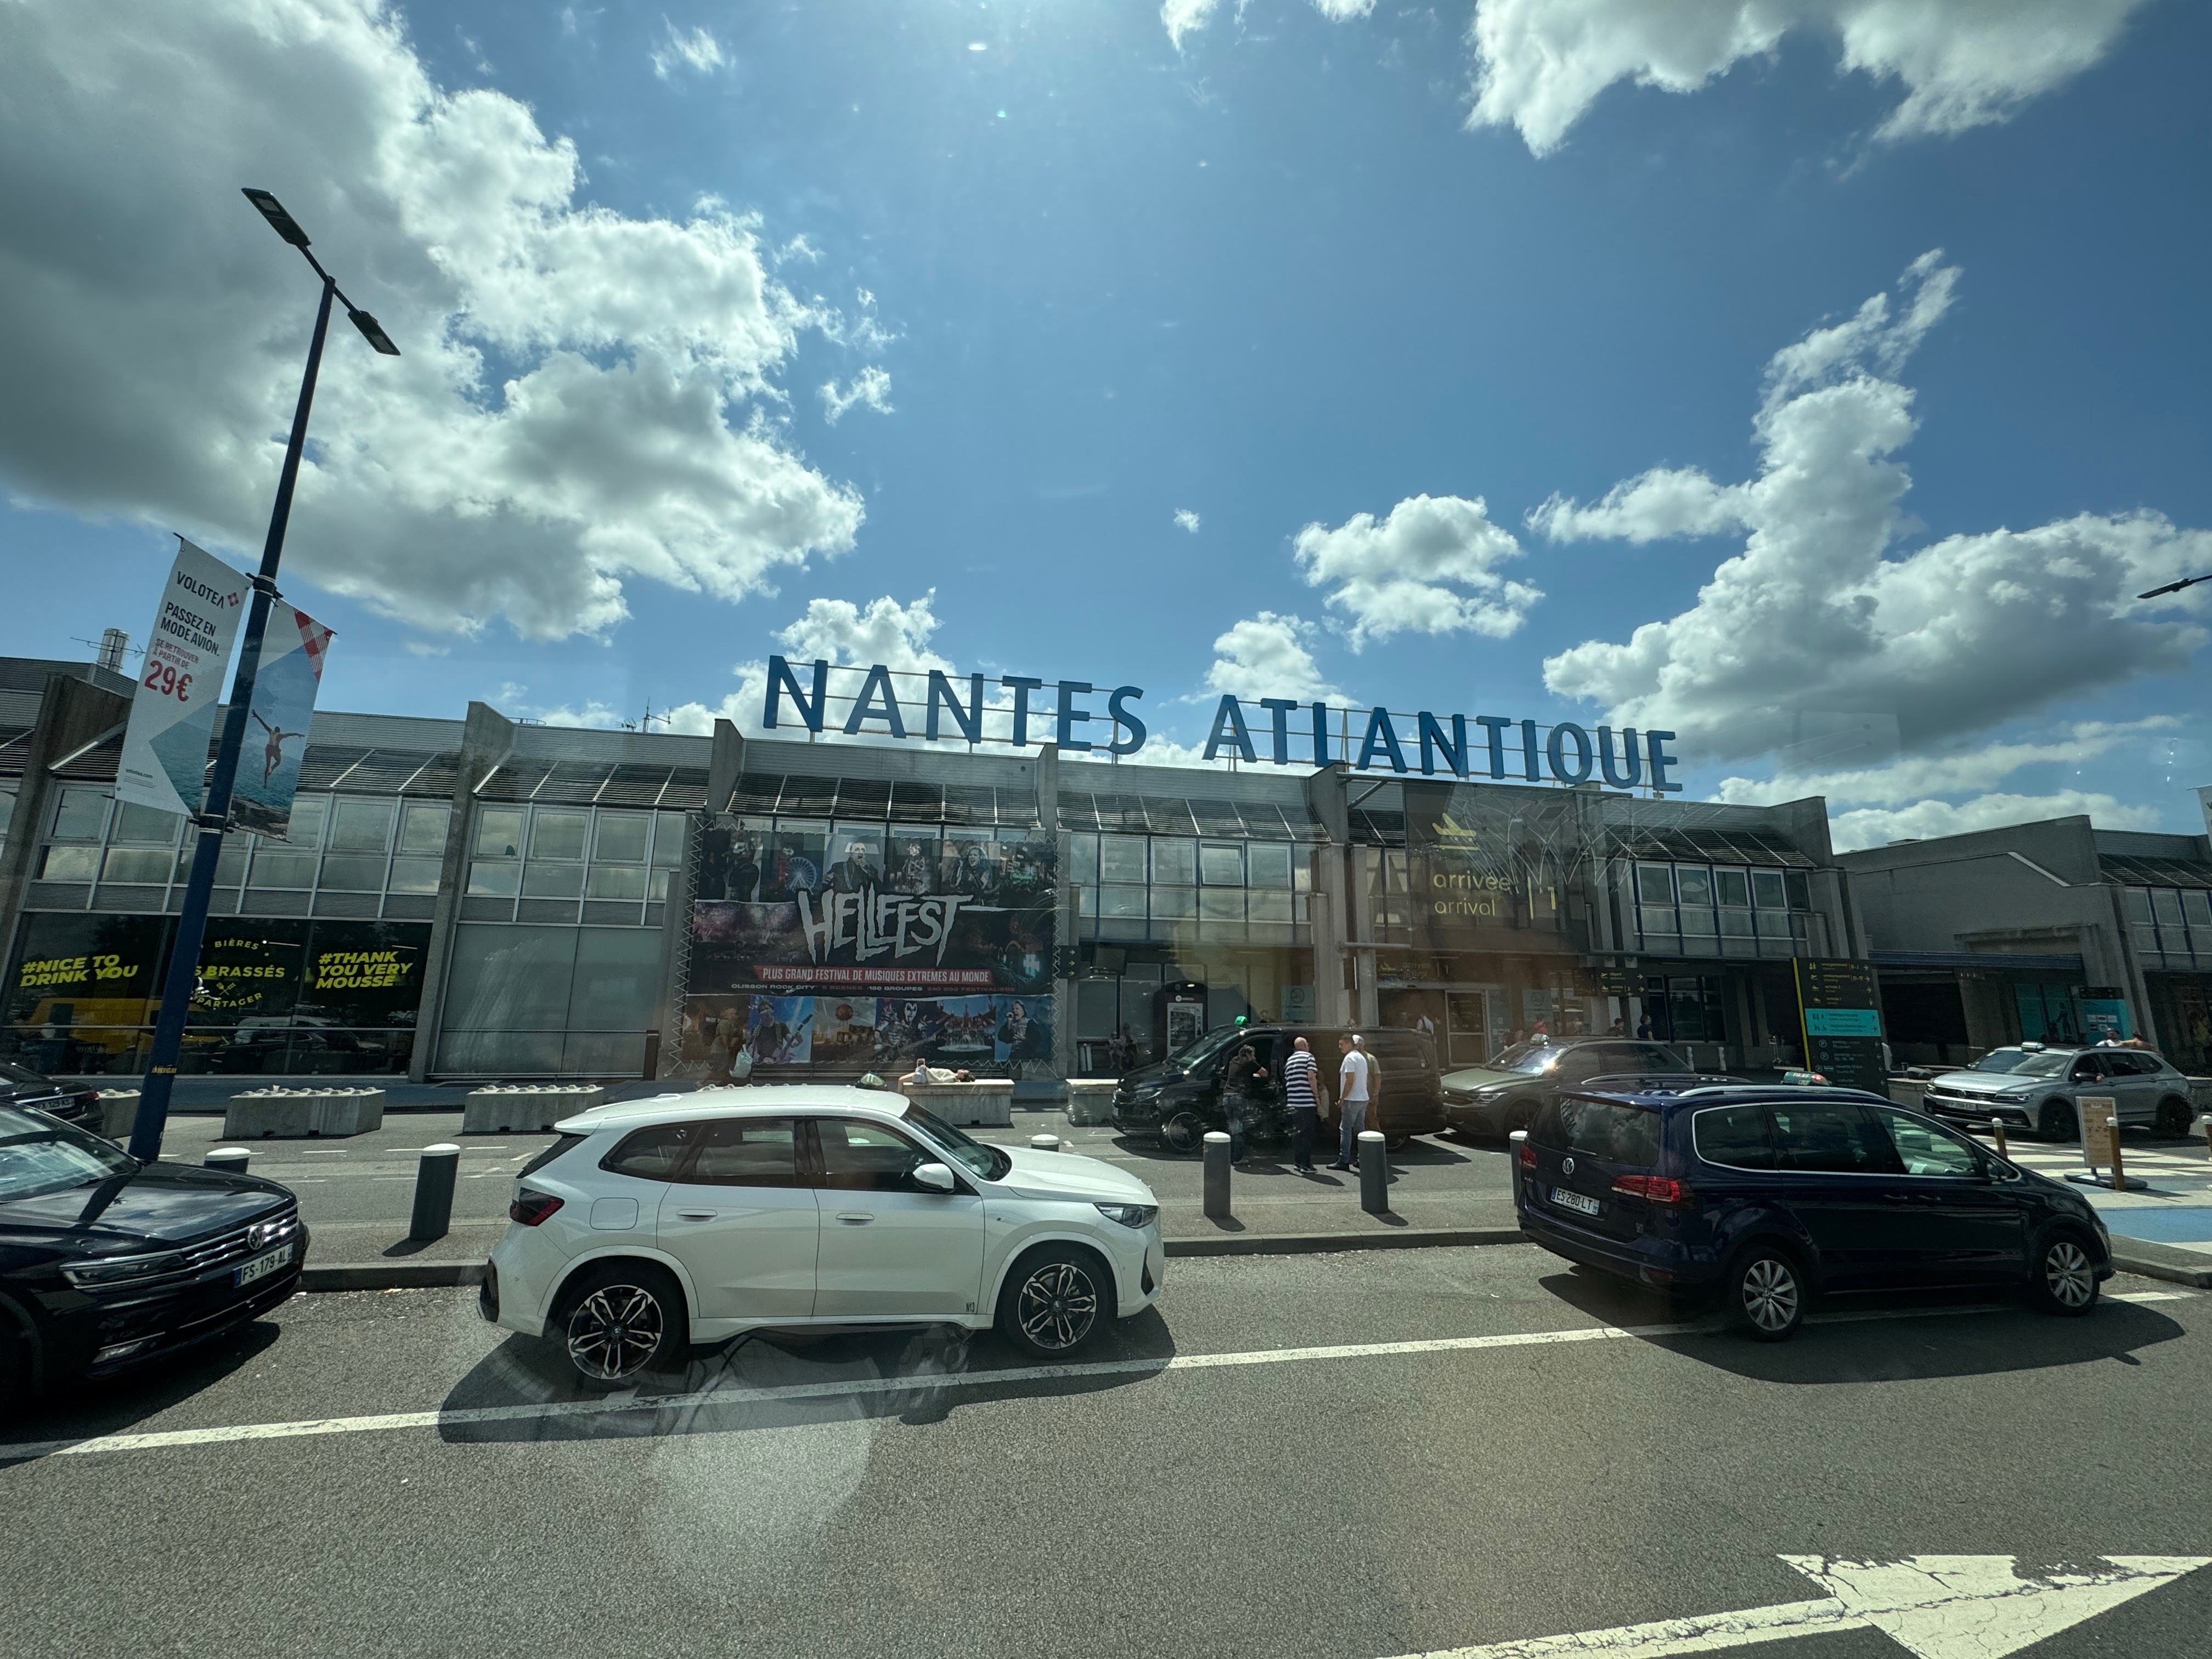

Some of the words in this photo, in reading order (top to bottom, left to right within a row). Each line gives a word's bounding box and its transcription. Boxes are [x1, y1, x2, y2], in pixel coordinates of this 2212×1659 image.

[177, 571, 224, 609] VOLOTEA
[165, 601, 204, 630] PASSEZ
[203, 620, 217, 637] EN
[160, 617, 191, 641] MODE
[190, 632, 219, 656] AVION.
[155, 638, 165, 648] SE
[165, 641, 199, 664] RETROUVER
[158, 650, 181, 666] PARTIR
[180, 659, 190, 669] DE
[144, 660, 193, 702] 29€
[763, 654, 1147, 755] NANTES
[1202, 694, 1683, 792] ATLANTIQUE
[1432, 870, 1511, 892] arrivée
[1434, 898, 1496, 916] arrival
[1548, 887, 1556, 910] 1
[798, 881, 974, 967] HELLFEST
[215, 938, 259, 950] BIÈRES
[21, 957, 88, 974] #NICE
[92, 954, 120, 968] TO
[318, 951, 399, 964] #THANK
[20, 969, 91, 987] DRINK
[95, 964, 139, 980] YOU
[207, 964, 286, 978] BRASSÉS
[319, 964, 359, 977] YOU
[364, 962, 414, 975] VERY
[763, 968, 783, 980] PLUS
[785, 969, 813, 980] GRAND
[815, 969, 850, 980] FESTIVAL
[853, 970, 862, 981] DE
[864, 970, 905, 982] MUSIQUES
[907, 970, 947, 983] EXTREMES
[949, 971, 960, 982] AU
[961, 972, 989, 983] MONDE
[315, 975, 396, 989] MOUSSE
[196, 992, 263, 1007] PARTAGER
